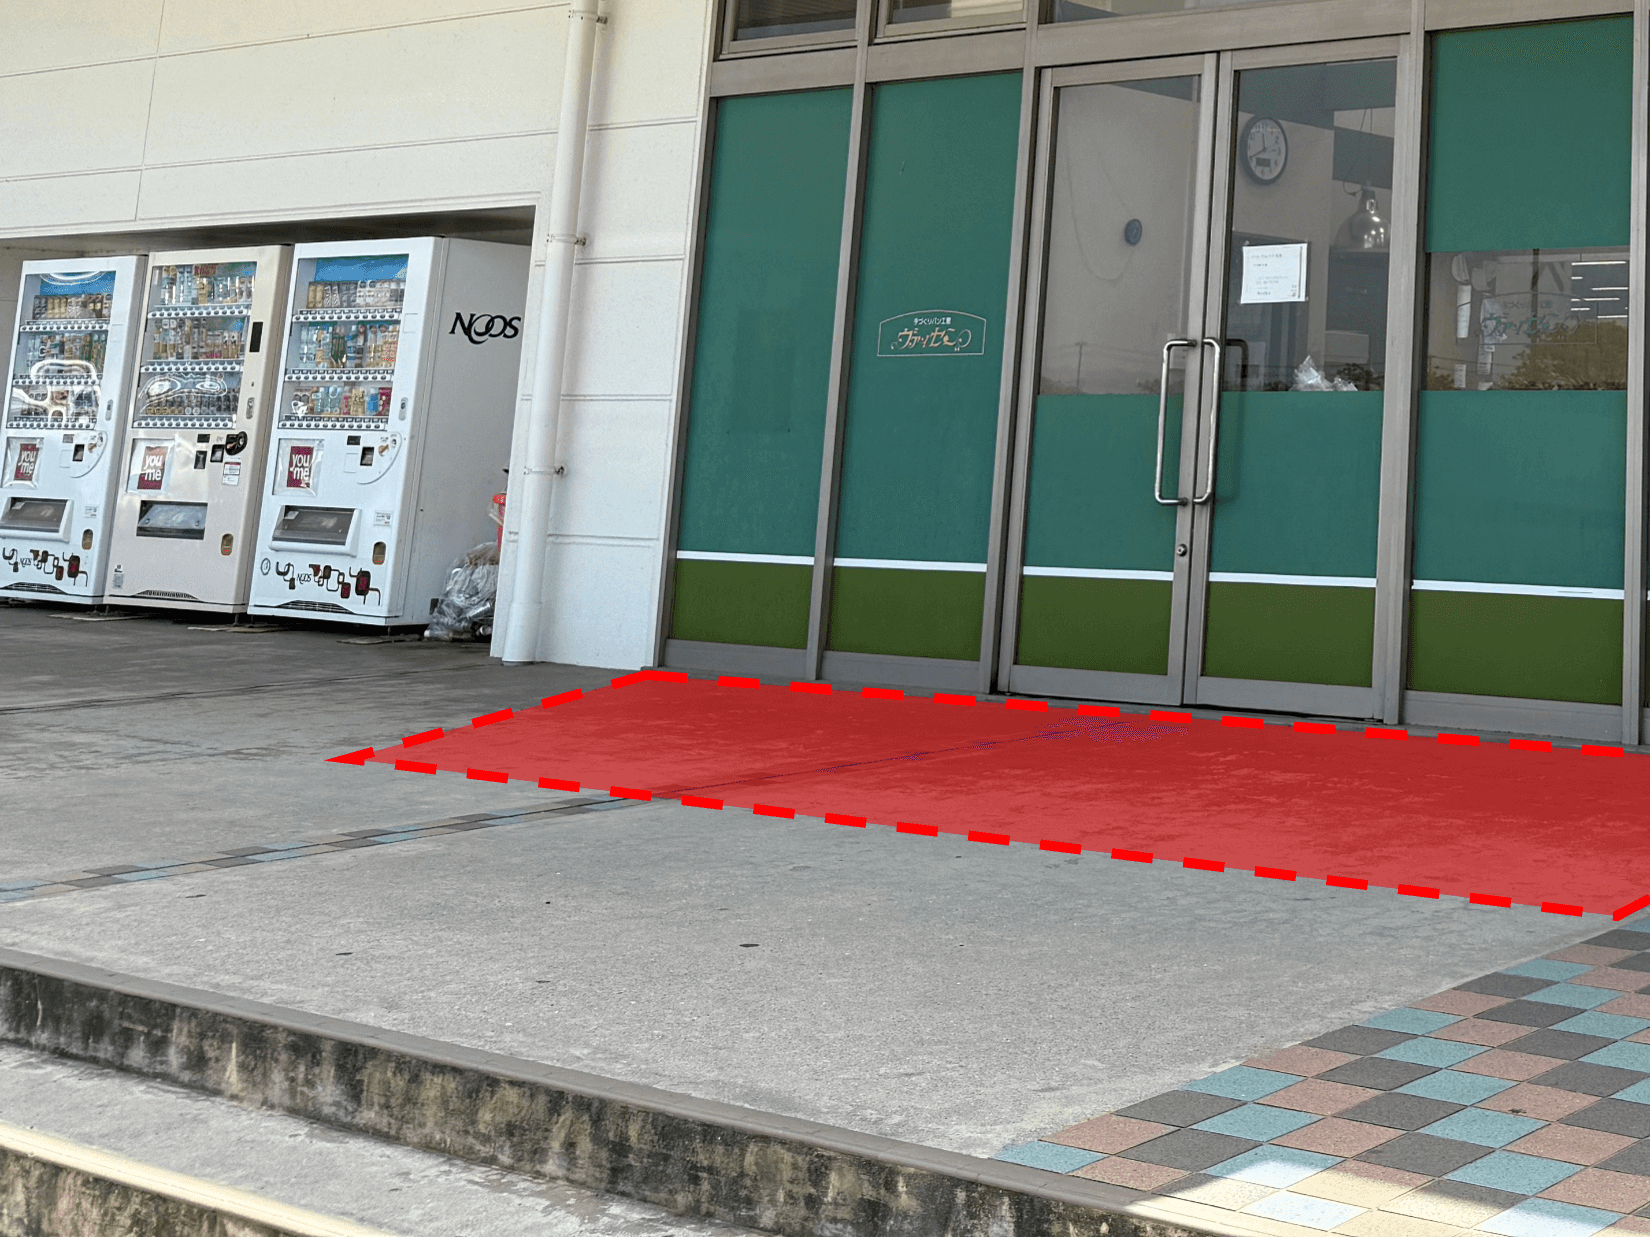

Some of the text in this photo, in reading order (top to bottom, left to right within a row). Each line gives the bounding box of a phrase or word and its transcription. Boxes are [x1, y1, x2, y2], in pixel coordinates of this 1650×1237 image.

[449, 311, 522, 345] NOOS
[144, 454, 163, 470] you
[290, 454, 310, 472] you
